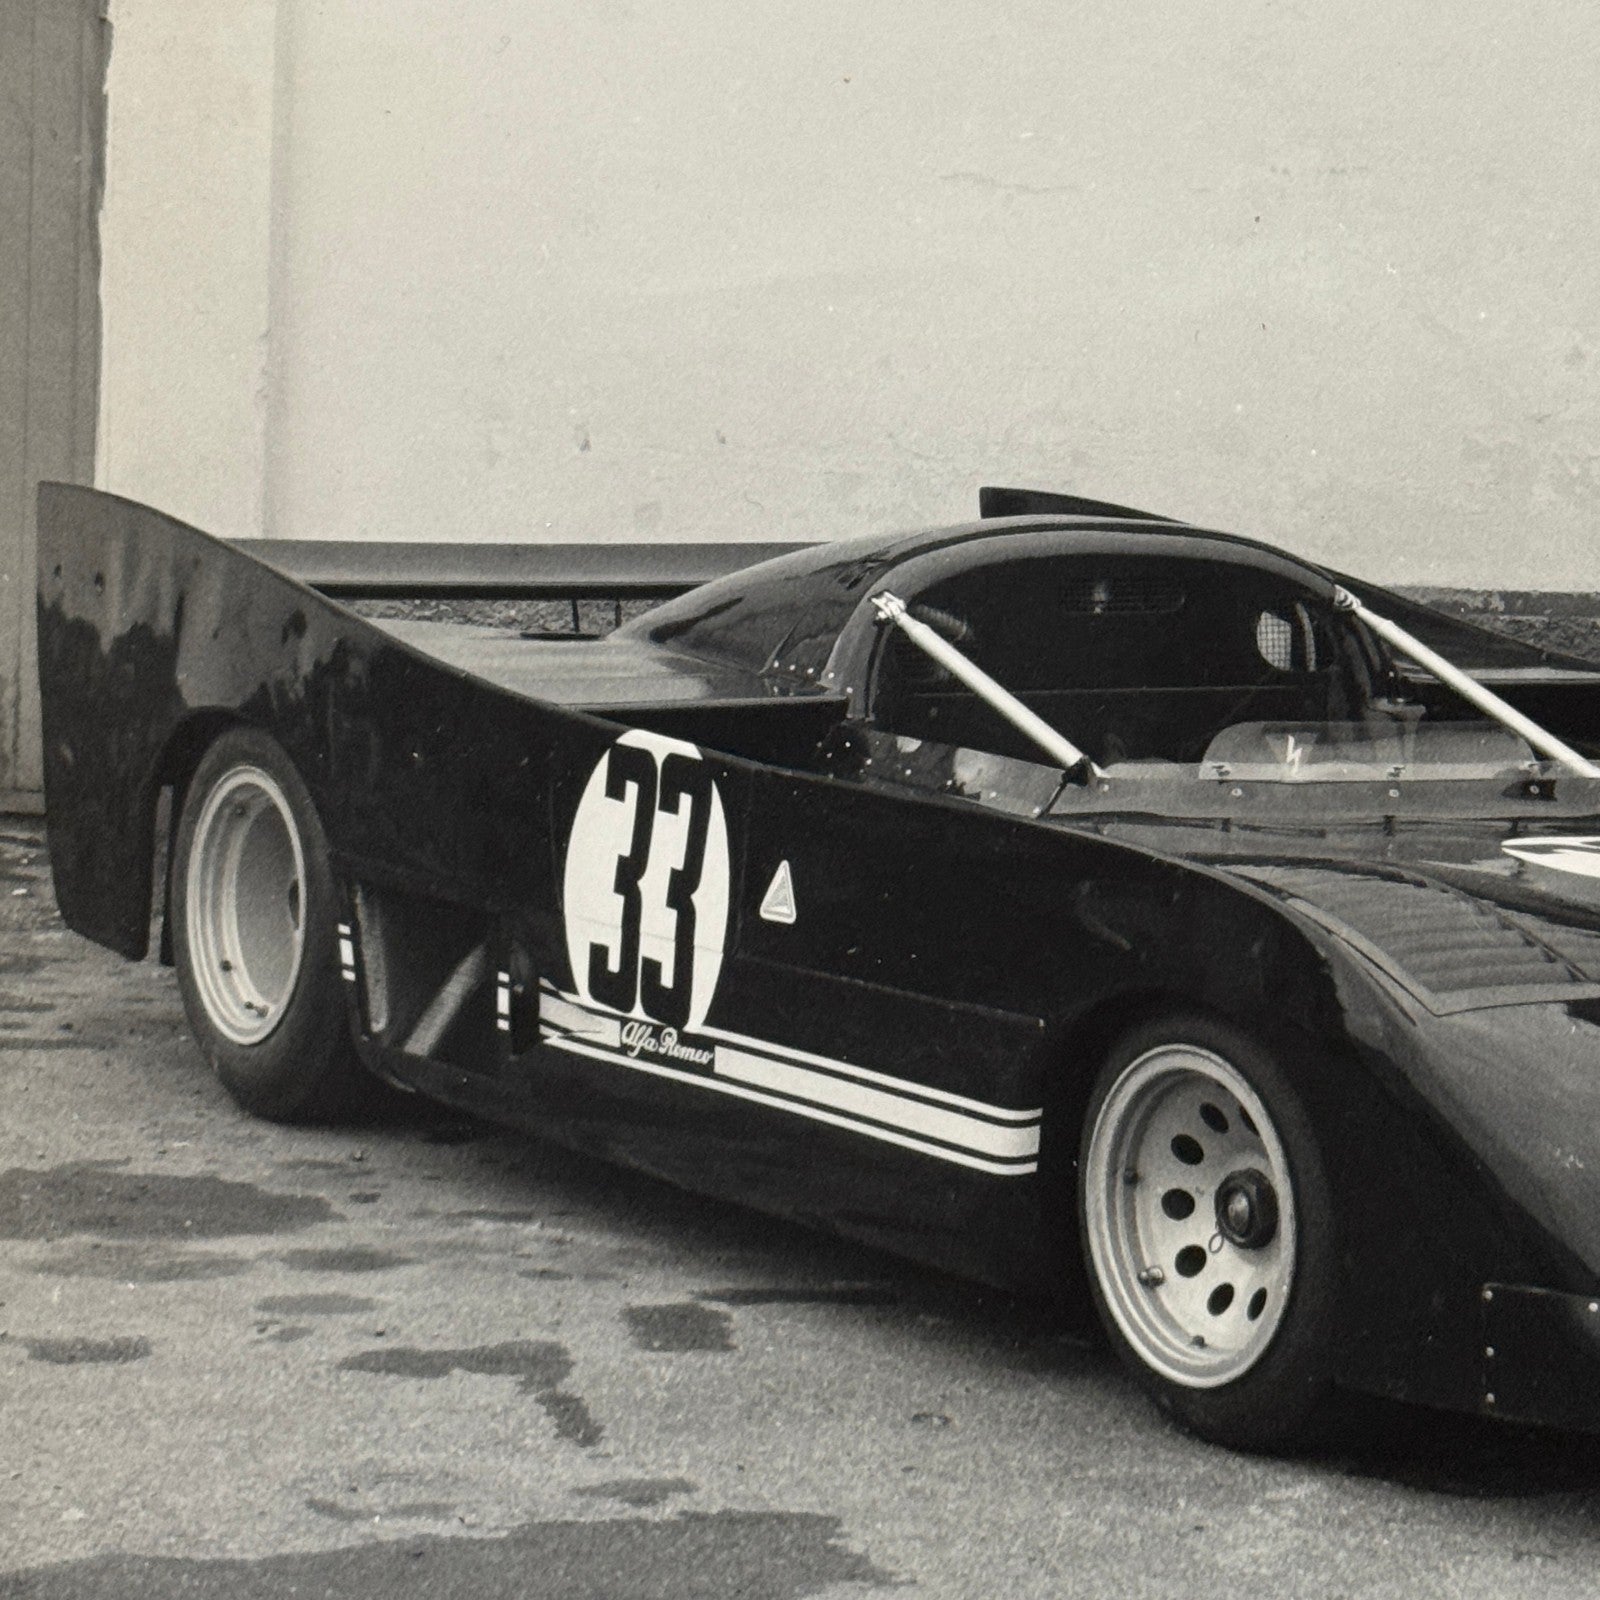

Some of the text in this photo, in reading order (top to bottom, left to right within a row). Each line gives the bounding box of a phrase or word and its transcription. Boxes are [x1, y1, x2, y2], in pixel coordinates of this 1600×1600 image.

[588, 743, 713, 1027] 33
[621, 1021, 714, 1065] Alfa Romeo
